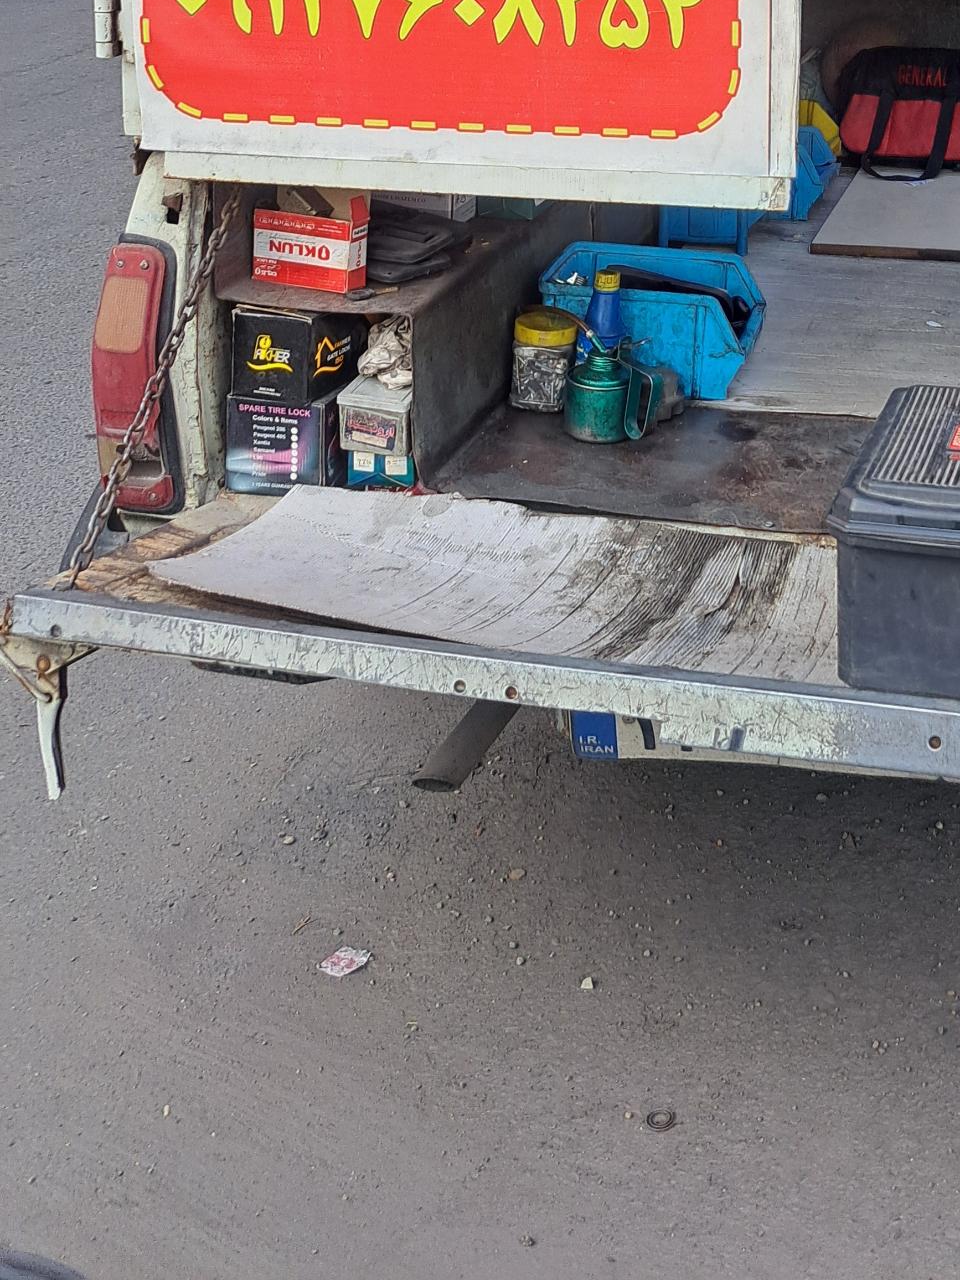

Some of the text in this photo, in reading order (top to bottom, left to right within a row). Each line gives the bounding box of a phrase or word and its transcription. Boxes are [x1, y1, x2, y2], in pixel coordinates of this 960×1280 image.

[238, 403, 311, 417] SPARE TIRE LOCK
[580, 745, 614, 753] IRAN
